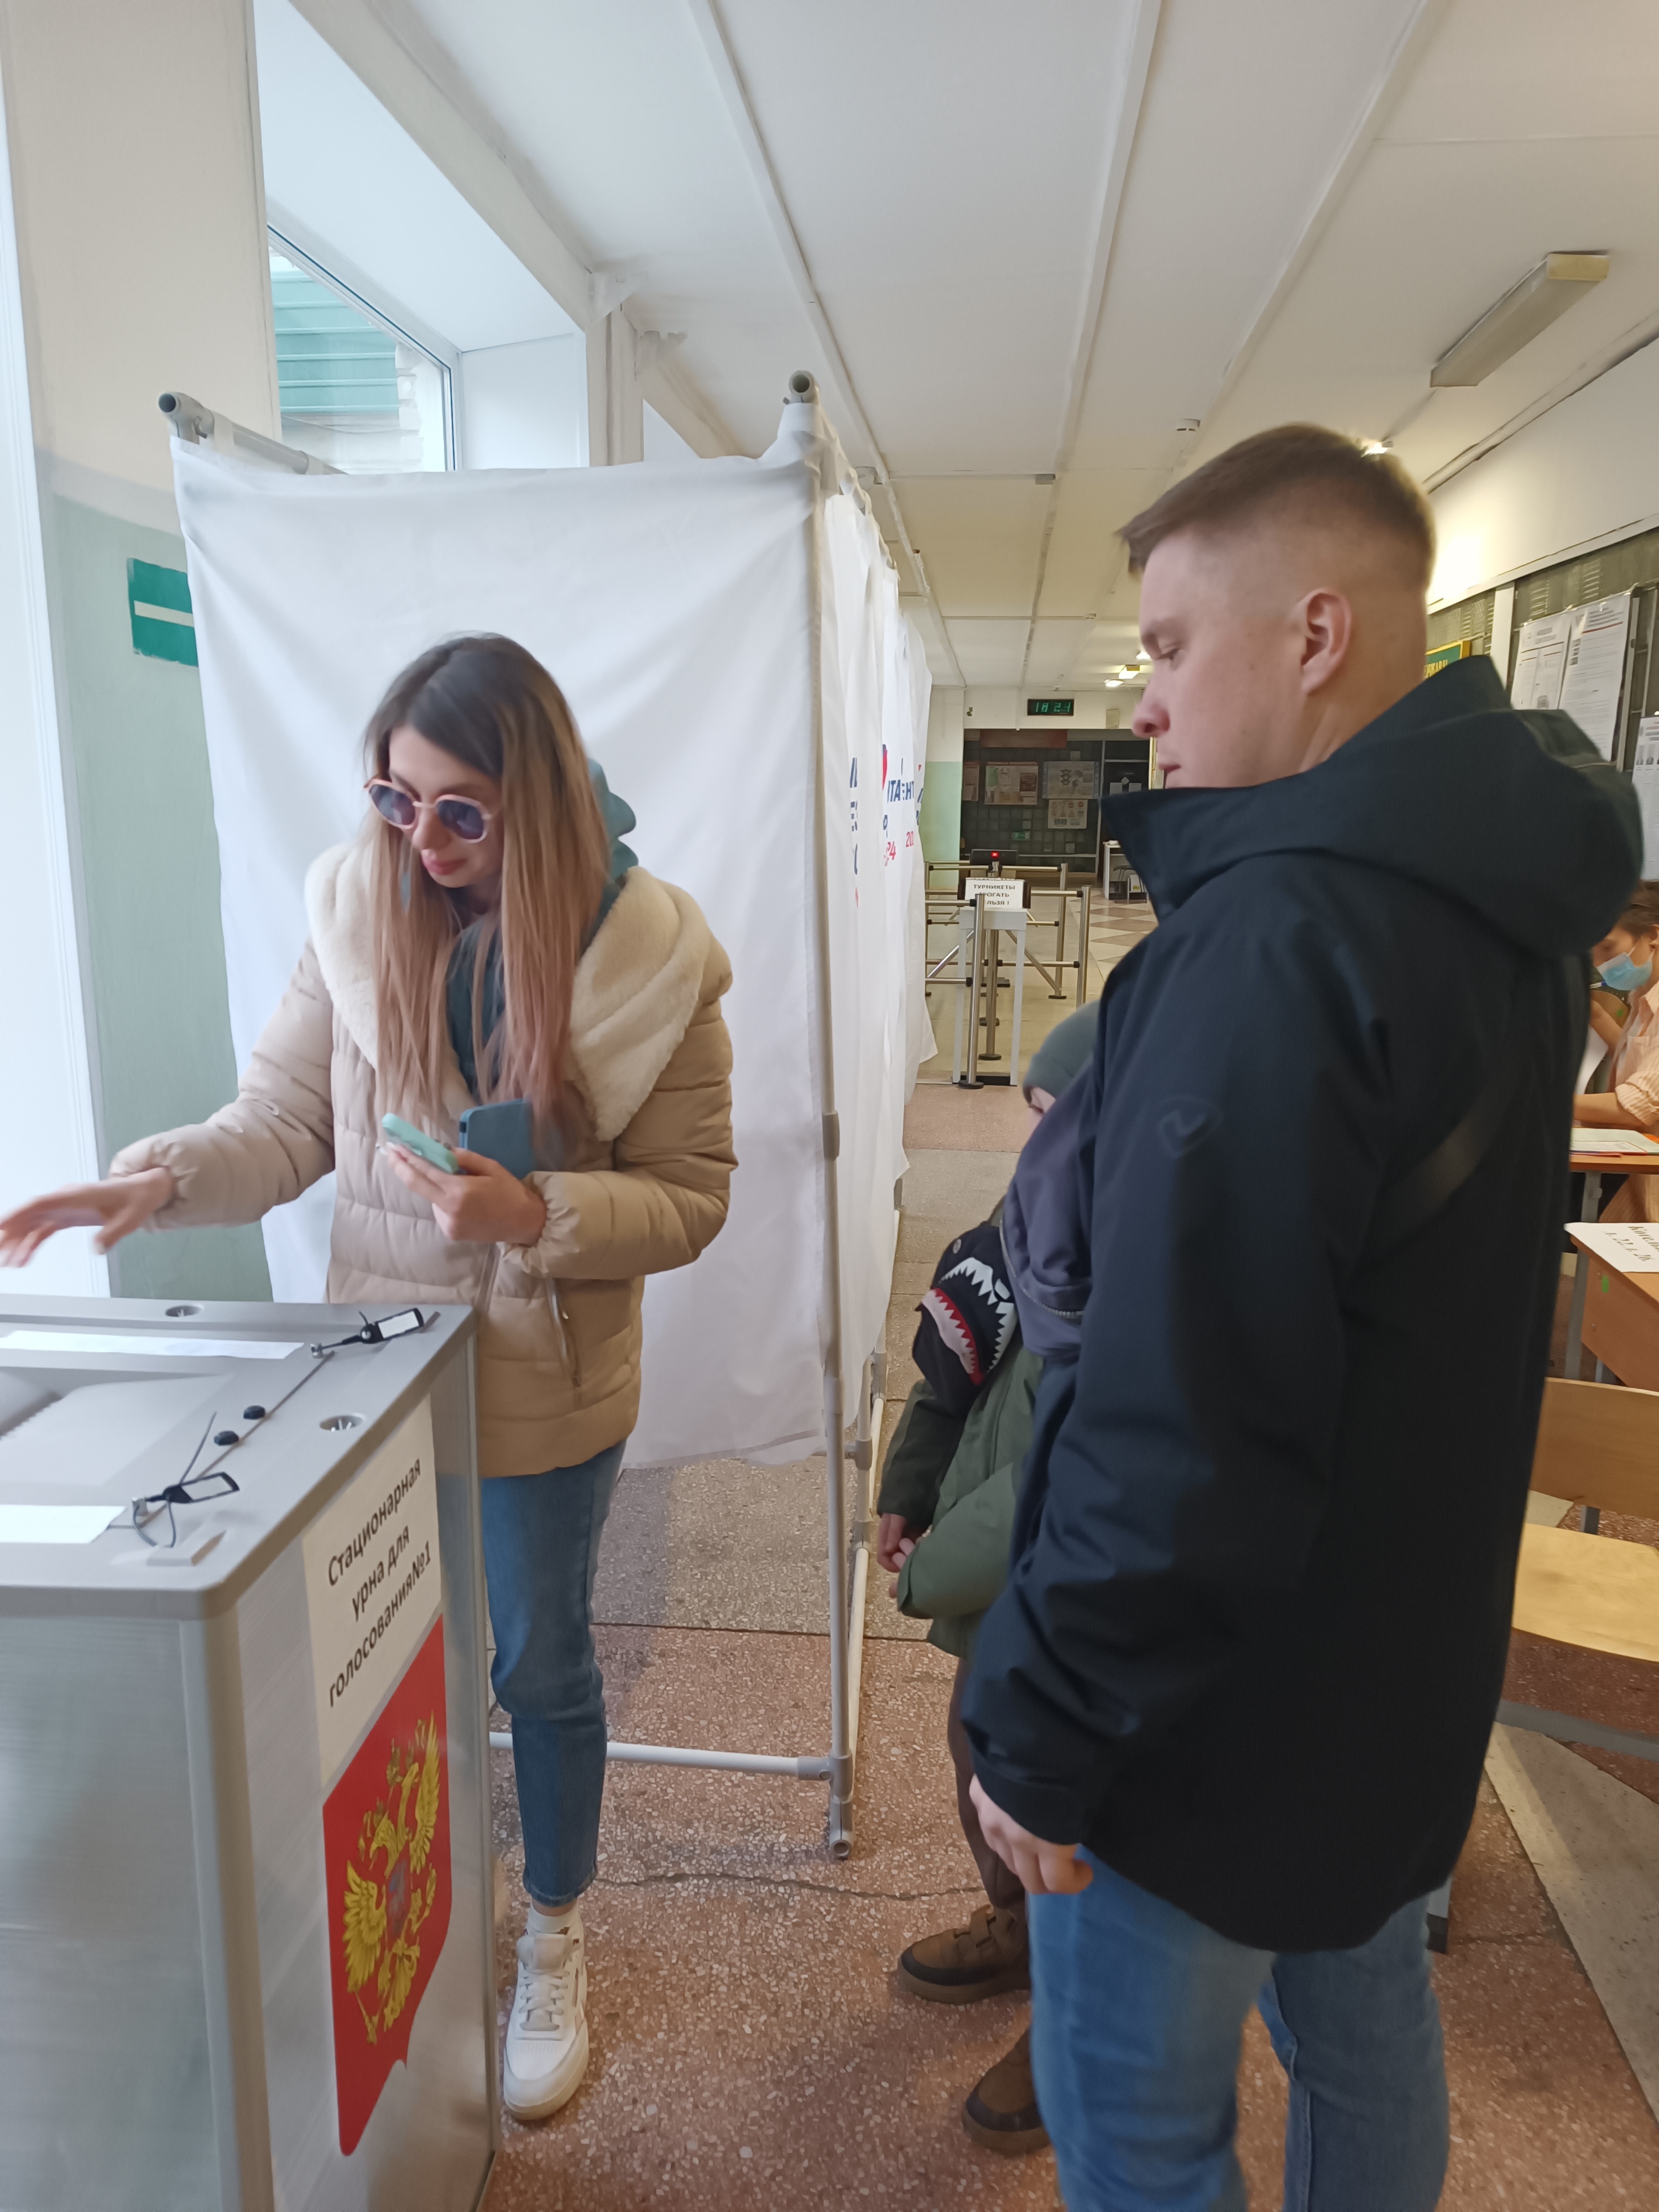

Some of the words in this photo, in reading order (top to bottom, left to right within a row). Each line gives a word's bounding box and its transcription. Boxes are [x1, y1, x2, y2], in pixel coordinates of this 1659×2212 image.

[328, 1458, 421, 1586] Стационарная
[352, 1561, 385, 1622] урна
[388, 1525, 409, 1576] для
